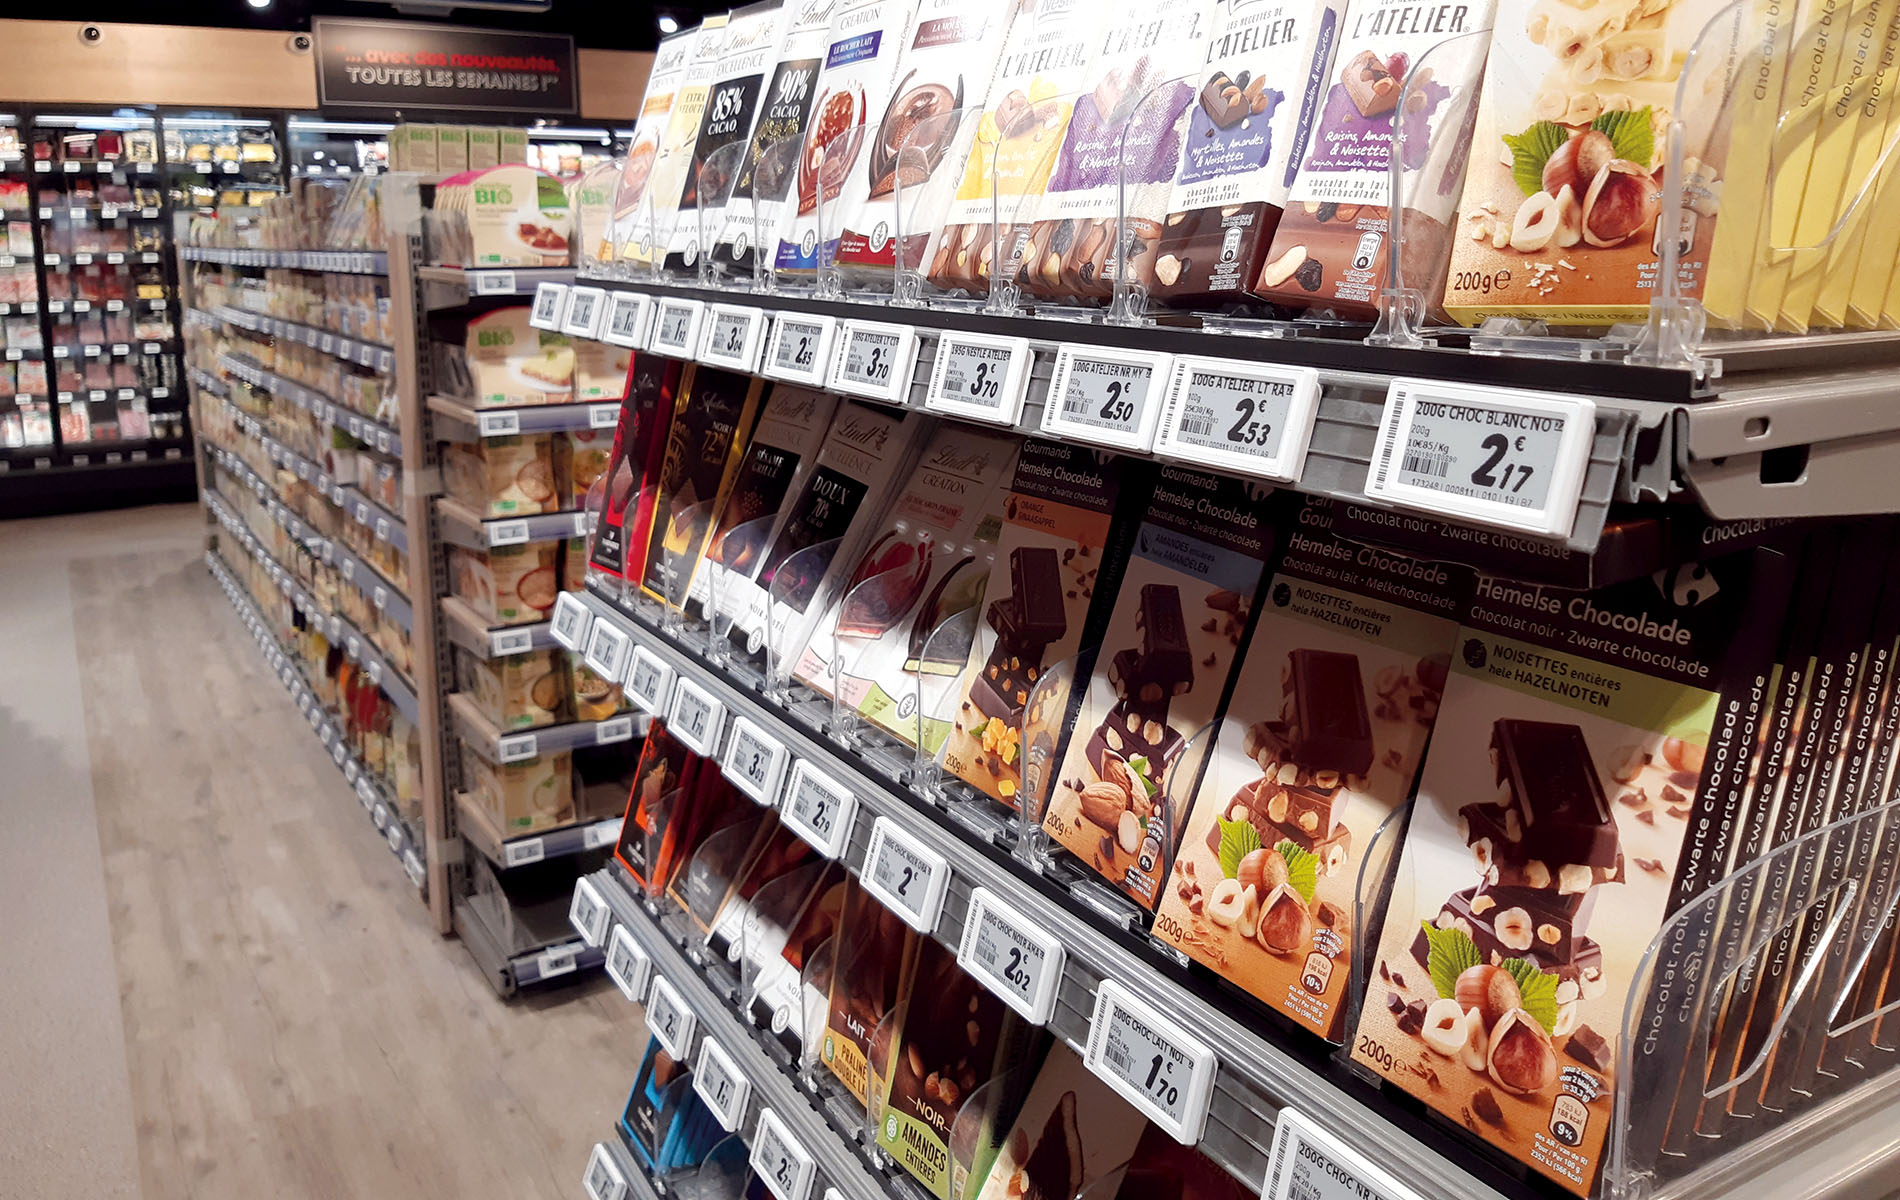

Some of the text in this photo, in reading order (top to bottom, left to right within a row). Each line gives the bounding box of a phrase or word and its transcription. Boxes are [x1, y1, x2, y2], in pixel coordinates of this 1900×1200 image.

[840, 7, 883, 31] CREATION
[365, 51, 411, 65] avec
[414, 51, 447, 66] des
[716, 53, 766, 77] EXCELLENCE
[1754, 20, 1778, 101] Chocolat
[1800, 31, 1830, 108] Chocolat
[425, 70, 453, 88] LES
[456, 72, 538, 91] SEMAINES
[773, 69, 812, 105] 90%
[1835, 42, 1869, 118] Chocolat
[1864, 44, 1896, 118] Chocolat
[712, 85, 746, 122] 85%
[770, 104, 800, 118] CACAO
[708, 122, 737, 136] CACAO
[1228, 134, 1264, 151] Amandes
[1324, 131, 1358, 144] Raisins,
[1205, 151, 1244, 167] Noisettes
[1340, 143, 1389, 158] Noisettes
[475, 189, 513, 204] BIO
[1311, 187, 1380, 200] melkchocolade
[1453, 272, 1492, 294] 200g
[478, 330, 515, 347] BIO
[1073, 361, 1090, 373] 100G
[1091, 363, 1120, 376] ATELIER
[1192, 373, 1214, 387] 100G
[1216, 375, 1254, 393] ATELIER
[1257, 382, 1268, 394] LT
[1411, 424, 1430, 438] 200g
[1416, 401, 1551, 432] 200G CHOC BLANC NO
[1023, 439, 1071, 461] Gourmands
[1407, 438, 1449, 454] 10€85/Kg
[922, 472, 968, 496] CREATION
[1018, 459, 1104, 489] Hemelse Chocolade
[1161, 464, 1219, 492] Gourmands
[813, 475, 850, 505] DOUX
[1020, 501, 1045, 514] ORANGE
[1152, 485, 1259, 530] Hemelse Chocolade
[1147, 505, 1262, 551] Chocolat Zwarte chocolade
[1347, 505, 1401, 529] Chocolat
[1403, 516, 1430, 533] noir
[1440, 523, 1488, 545] Zwarte
[1155, 532, 1189, 554] AMANDES
[1289, 532, 1449, 586] Hemelse Chocolade
[1282, 556, 1457, 611] Chocolat au lait Melkchocolade
[1295, 586, 1392, 624] NOISETTES entières
[1475, 577, 1692, 645] Hemelse Chocolade
[1309, 608, 1382, 637] HAZELNOTEN
[1470, 606, 1710, 678] Chocolat noir Zwarte chocolade
[1492, 645, 1622, 691] NOISETTES entières
[1488, 664, 1610, 708] hele HAZELNOTEN
[1856, 648, 1887, 751] chocolade
[1780, 662, 1834, 841] Zwarte chocolade
[1809, 651, 1859, 829] Zwarte chocolade
[945, 753, 961, 774] 200g
[1711, 674, 1766, 862] Zwarte chocolade
[1746, 670, 1801, 853] Zwarte chocolade
[1866, 745, 1890, 809] Zwarte
[1046, 811, 1066, 836] 200g
[1643, 699, 1741, 1055] Chocolat Zwarte chocolade
[997, 920, 1013, 939] CHOC
[1012, 930, 1027, 949] NOIR
[1157, 914, 1184, 944] 200g
[847, 1013, 866, 1040] LAIT
[1113, 1005, 1185, 1065] 200G CHOC LAIT NOI
[1358, 1034, 1393, 1073] 200g
[833, 1054, 857, 1089] DOUBLE
[914, 1096, 946, 1133] NOIR
[901, 1121, 948, 1173] AMANDES
[1557, 1123, 1574, 1141] 9%
[905, 1147, 938, 1186] ENTIÈRES
[1299, 1142, 1353, 1190] 200G CHOC
